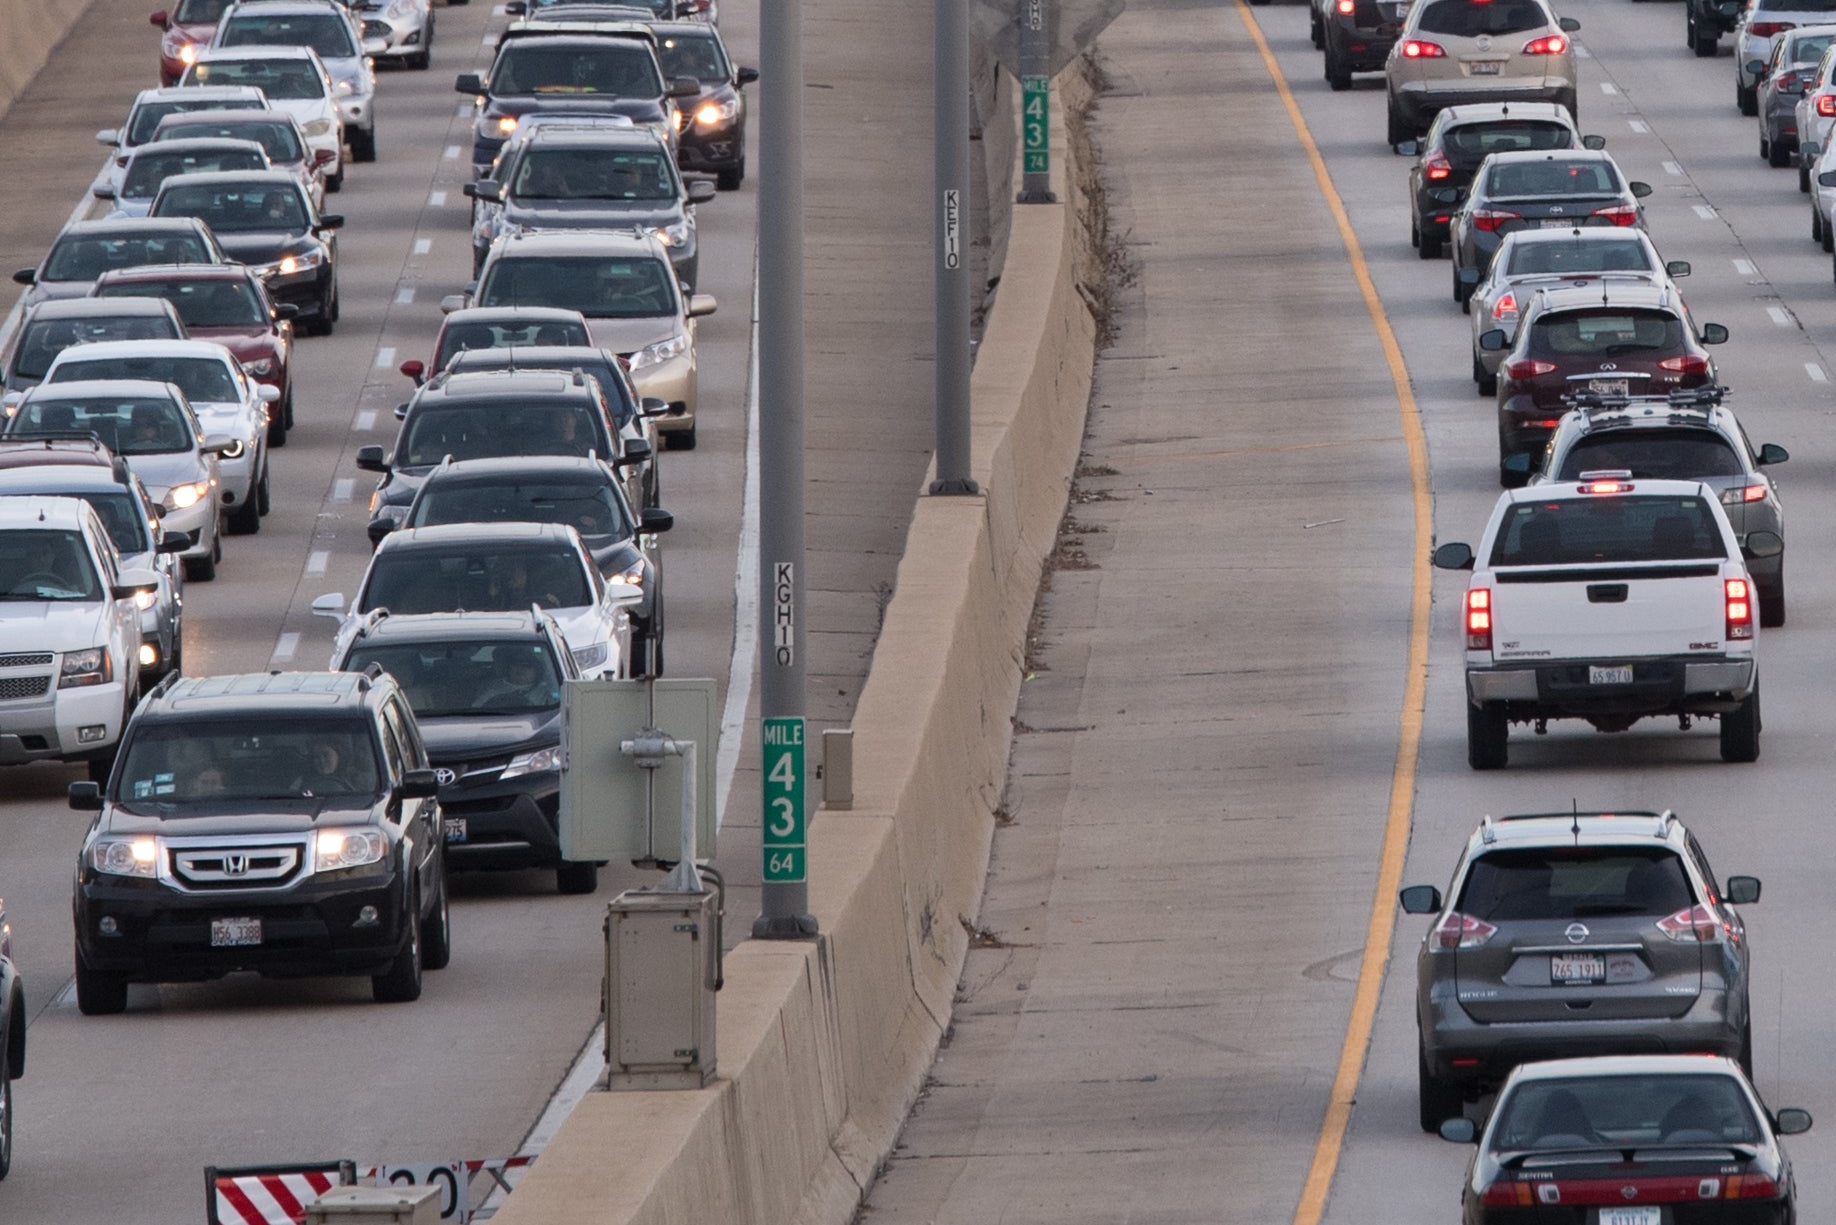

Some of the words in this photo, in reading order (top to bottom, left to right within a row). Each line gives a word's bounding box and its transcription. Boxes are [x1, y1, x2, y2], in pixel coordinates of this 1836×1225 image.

[1023, 78, 1049, 93] MILE
[1027, 97, 1043, 146] 43
[1030, 155, 1045, 168] 74
[1689, 642, 1718, 650] GMC
[765, 725, 801, 744] MILE
[769, 752, 795, 836] 43
[770, 853, 792, 872] 64
